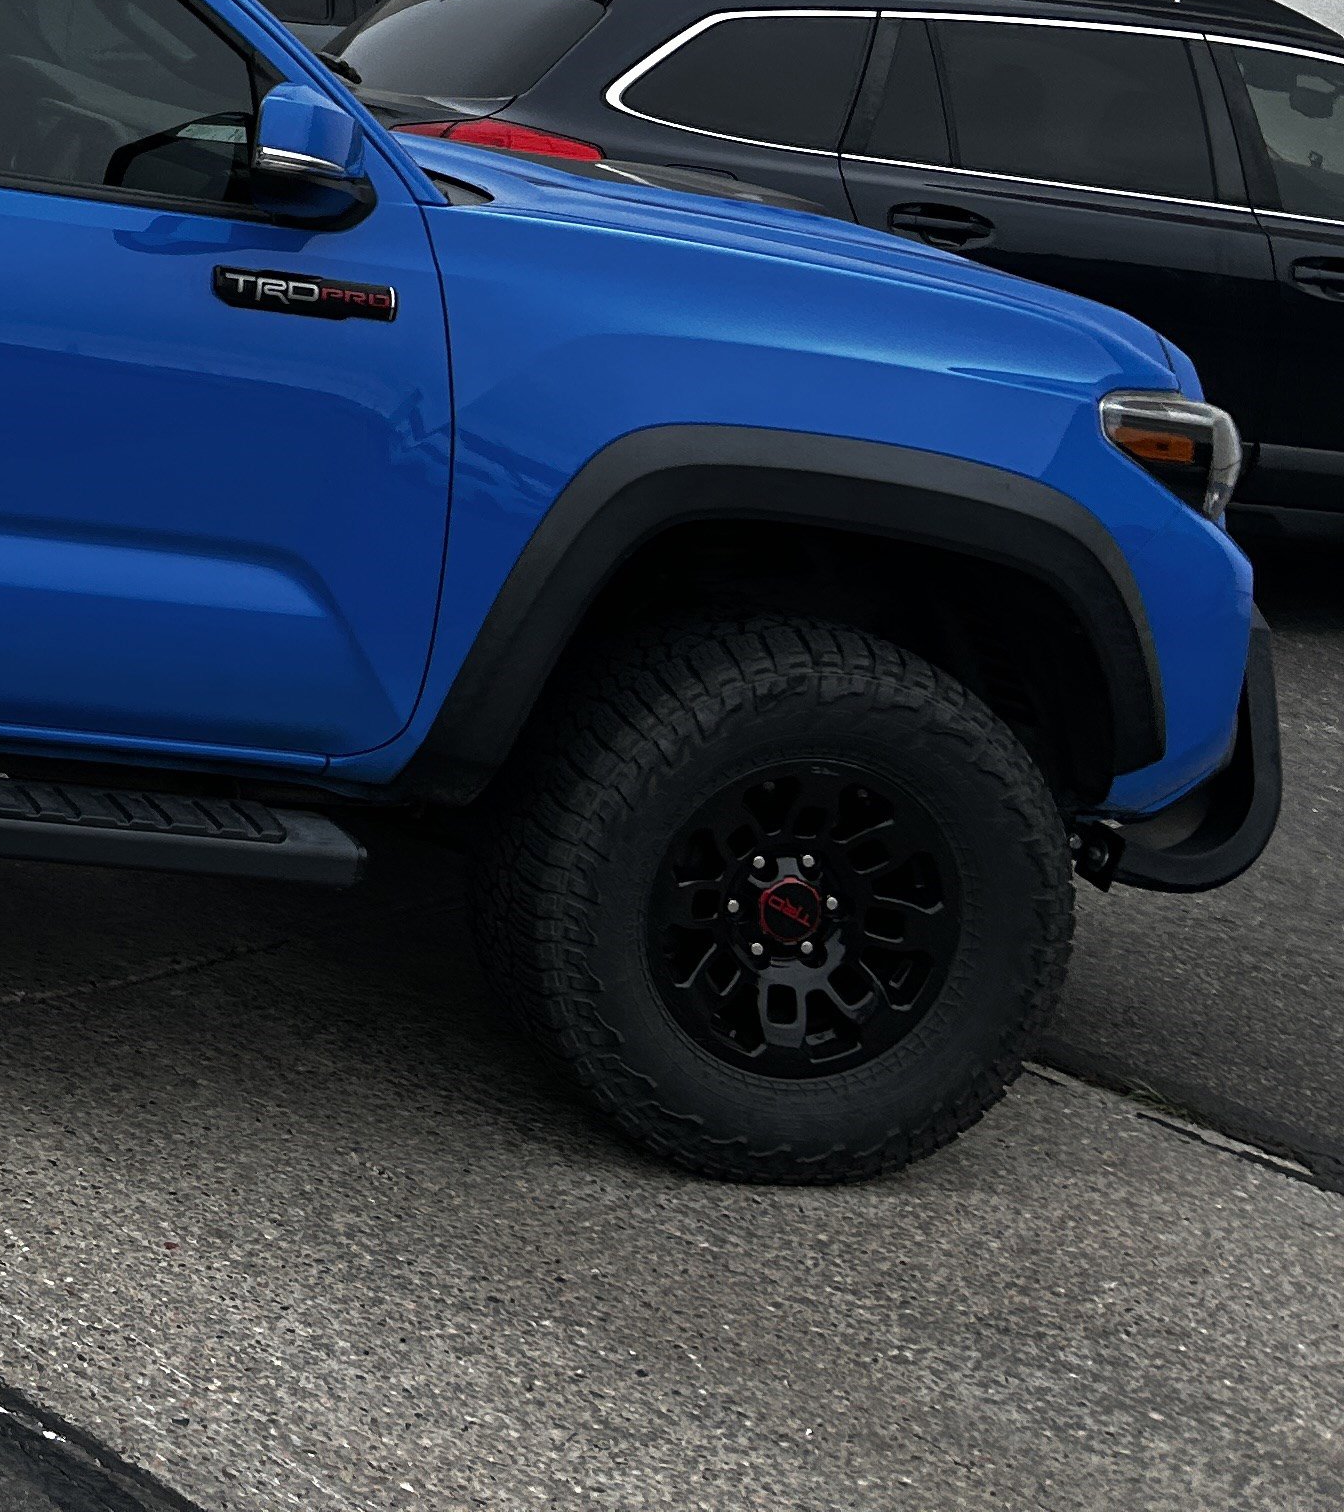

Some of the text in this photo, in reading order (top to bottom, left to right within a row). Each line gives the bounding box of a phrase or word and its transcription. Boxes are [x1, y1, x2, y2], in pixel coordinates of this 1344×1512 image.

[225, 272, 390, 308] TRD PRO
[769, 895, 811, 928] TRD
